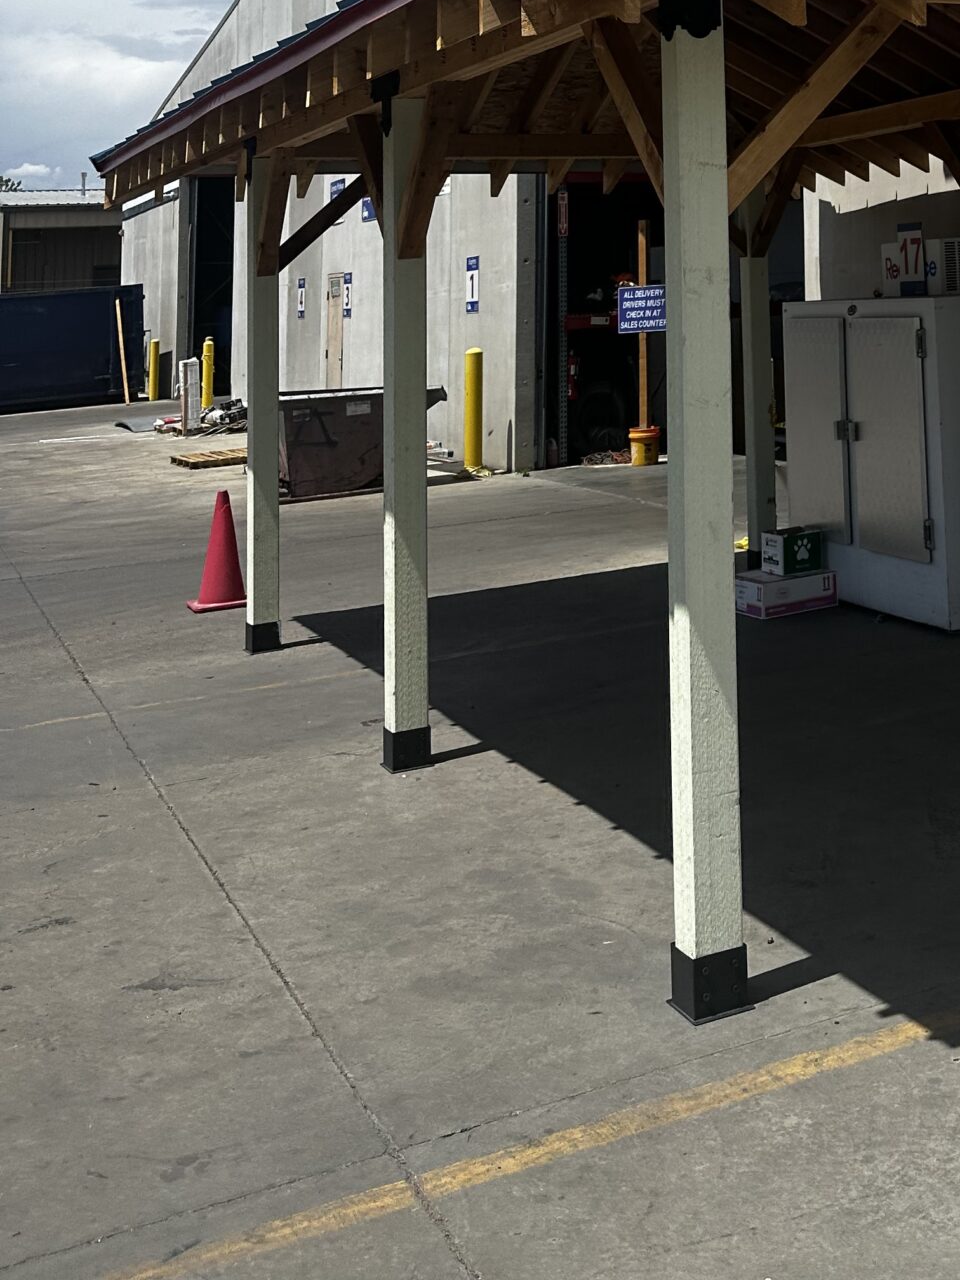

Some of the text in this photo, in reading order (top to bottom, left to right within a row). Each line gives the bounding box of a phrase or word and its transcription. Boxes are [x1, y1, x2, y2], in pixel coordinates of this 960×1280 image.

[900, 238, 922, 275] 17
[469, 273, 474, 299] 1
[345, 286, 350, 307] 3
[635, 289, 664, 298] DELIVERY
[623, 299, 665, 308] DRIVERS MUST
[626, 310, 644, 318] CHECK
[652, 309, 661, 317] AT
[620, 320, 638, 329] SALES
